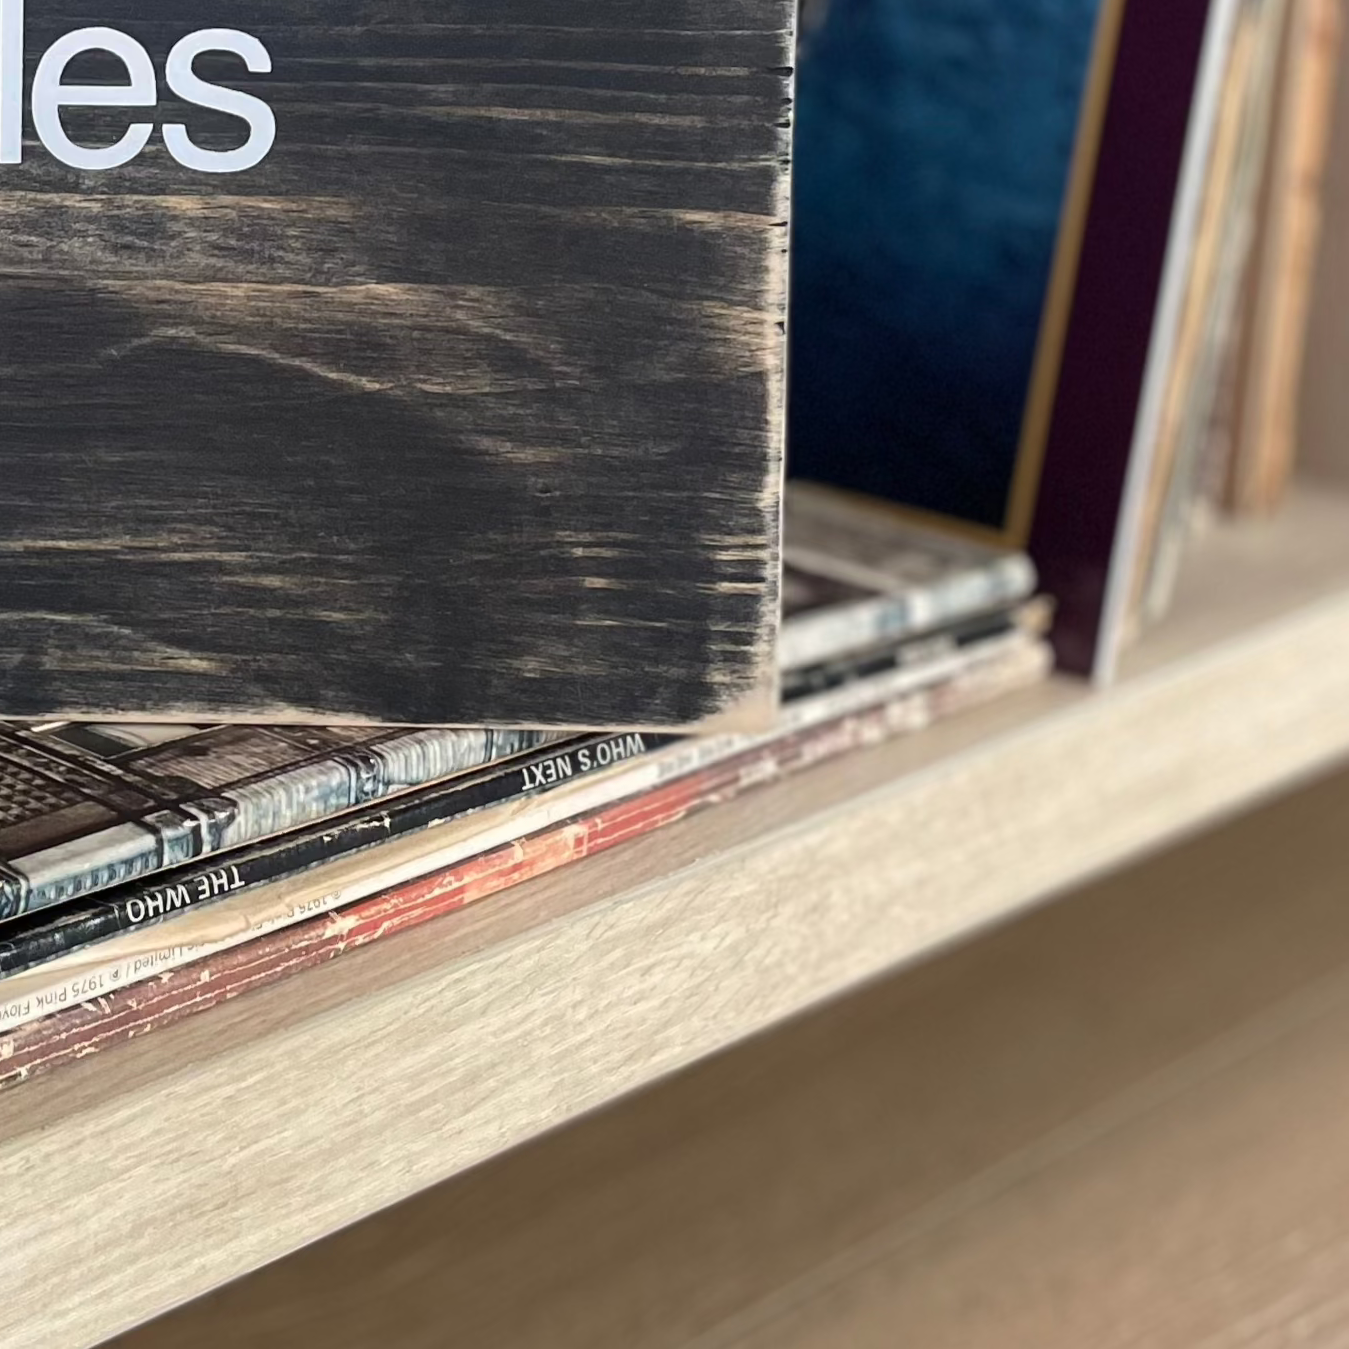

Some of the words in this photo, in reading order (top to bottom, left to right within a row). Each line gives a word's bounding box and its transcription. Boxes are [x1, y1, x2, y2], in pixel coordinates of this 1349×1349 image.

[576, 731, 646, 772] WHO'S
[519, 754, 573, 792] NEXT
[197, 864, 245, 901] THE
[126, 883, 189, 922] WHO
[33, 986, 69, 1016] Pink
[71, 972, 107, 1001] 1975
